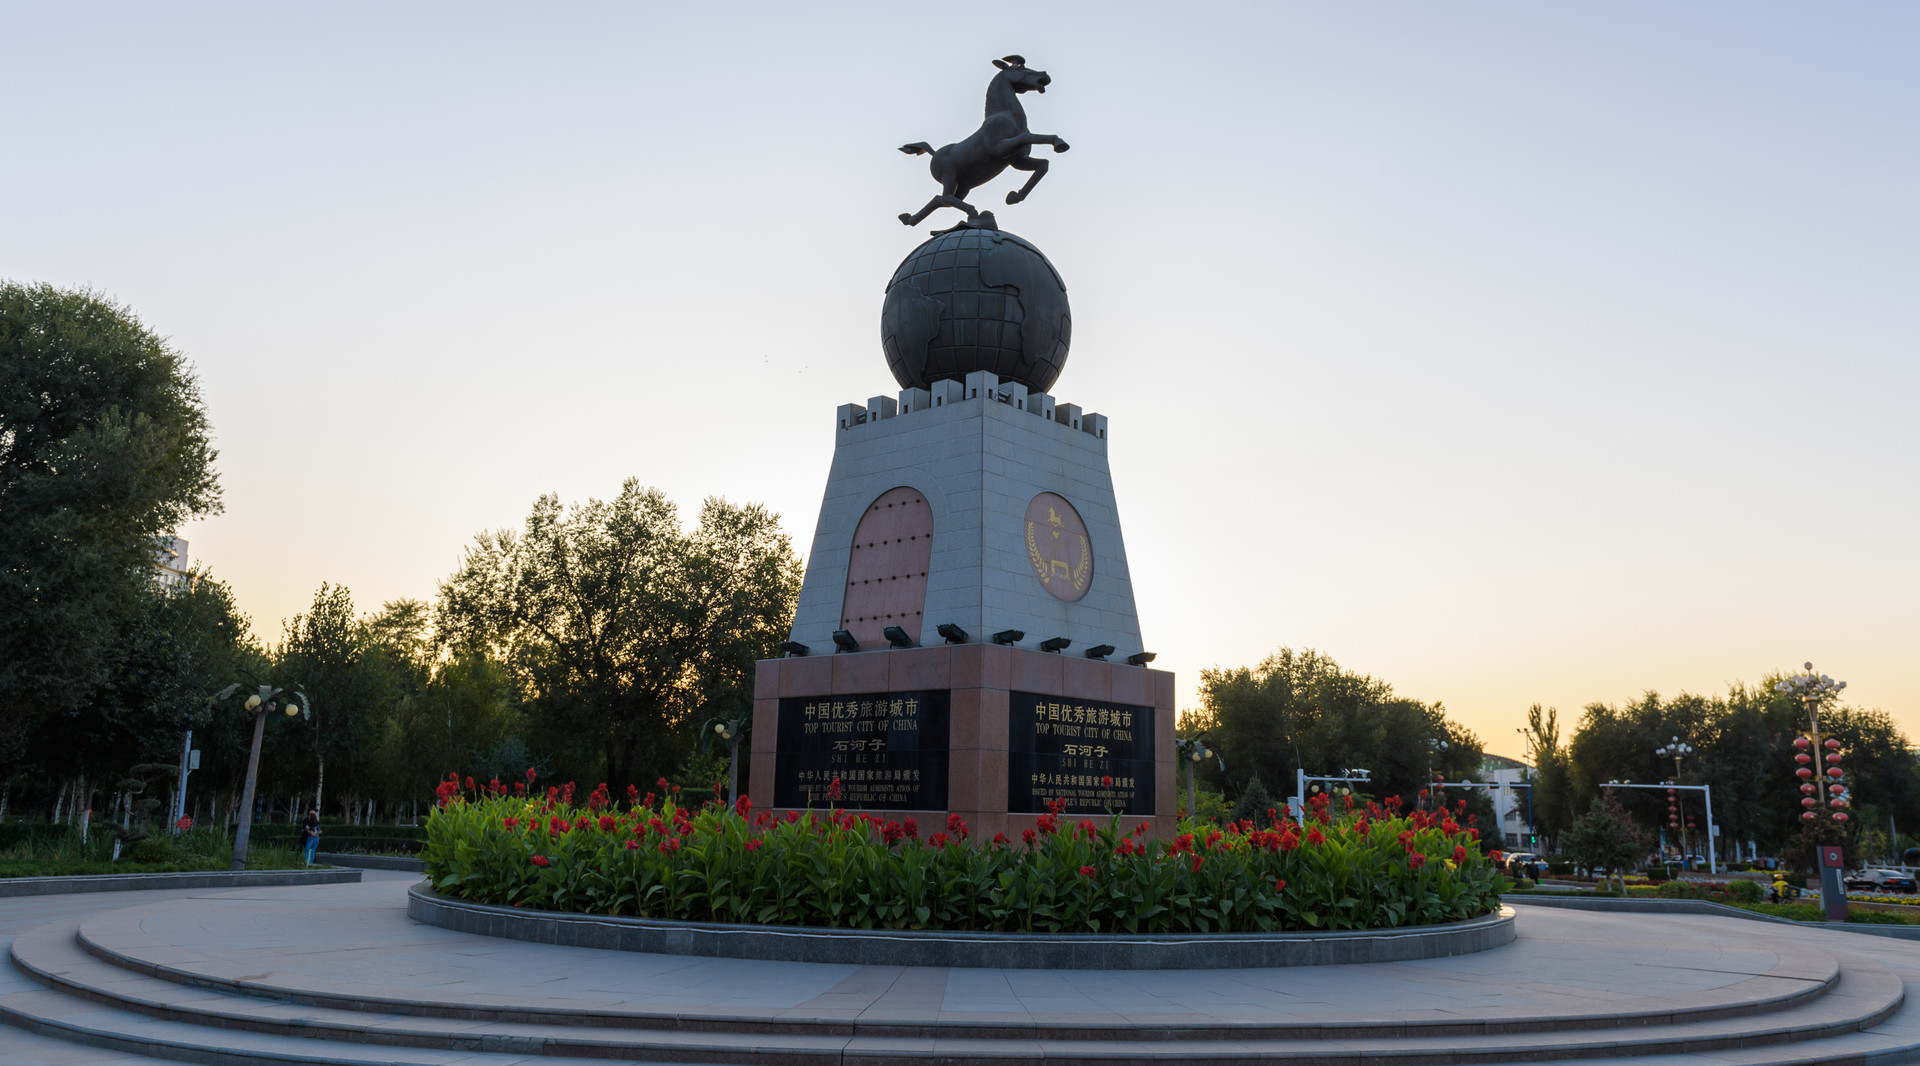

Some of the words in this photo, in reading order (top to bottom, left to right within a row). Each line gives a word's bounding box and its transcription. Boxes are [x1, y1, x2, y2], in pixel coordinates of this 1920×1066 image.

[805, 698, 918, 720] 中国优秀旅游城市
[1036, 702, 1132, 728] 中国优秀旅游城市
[804, 723, 818, 733] TOP
[822, 722, 853, 733] TOURIST
[857, 720, 874, 732] CITY
[878, 720, 889, 731] OF
[893, 719, 917, 731] CHINA
[1036, 723, 1050, 734] TOP
[1053, 724, 1081, 737] TOURIST
[1084, 726, 1099, 738] CITY
[1102, 729, 1110, 740] OF
[1113, 729, 1132, 741] CHINA
[832, 739, 886, 751] 石河子
[1063, 744, 1109, 758] 石河子
[831, 754, 847, 763] SHI
[856, 754, 867, 763] HE
[876, 754, 886, 763] ZI
[1062, 758, 1077, 767] SHI
[1084, 759, 1093, 768] HE
[1100, 760, 1109, 769] ZI
[879, 794, 887, 802] OF
[889, 793, 908, 802] CHINA
